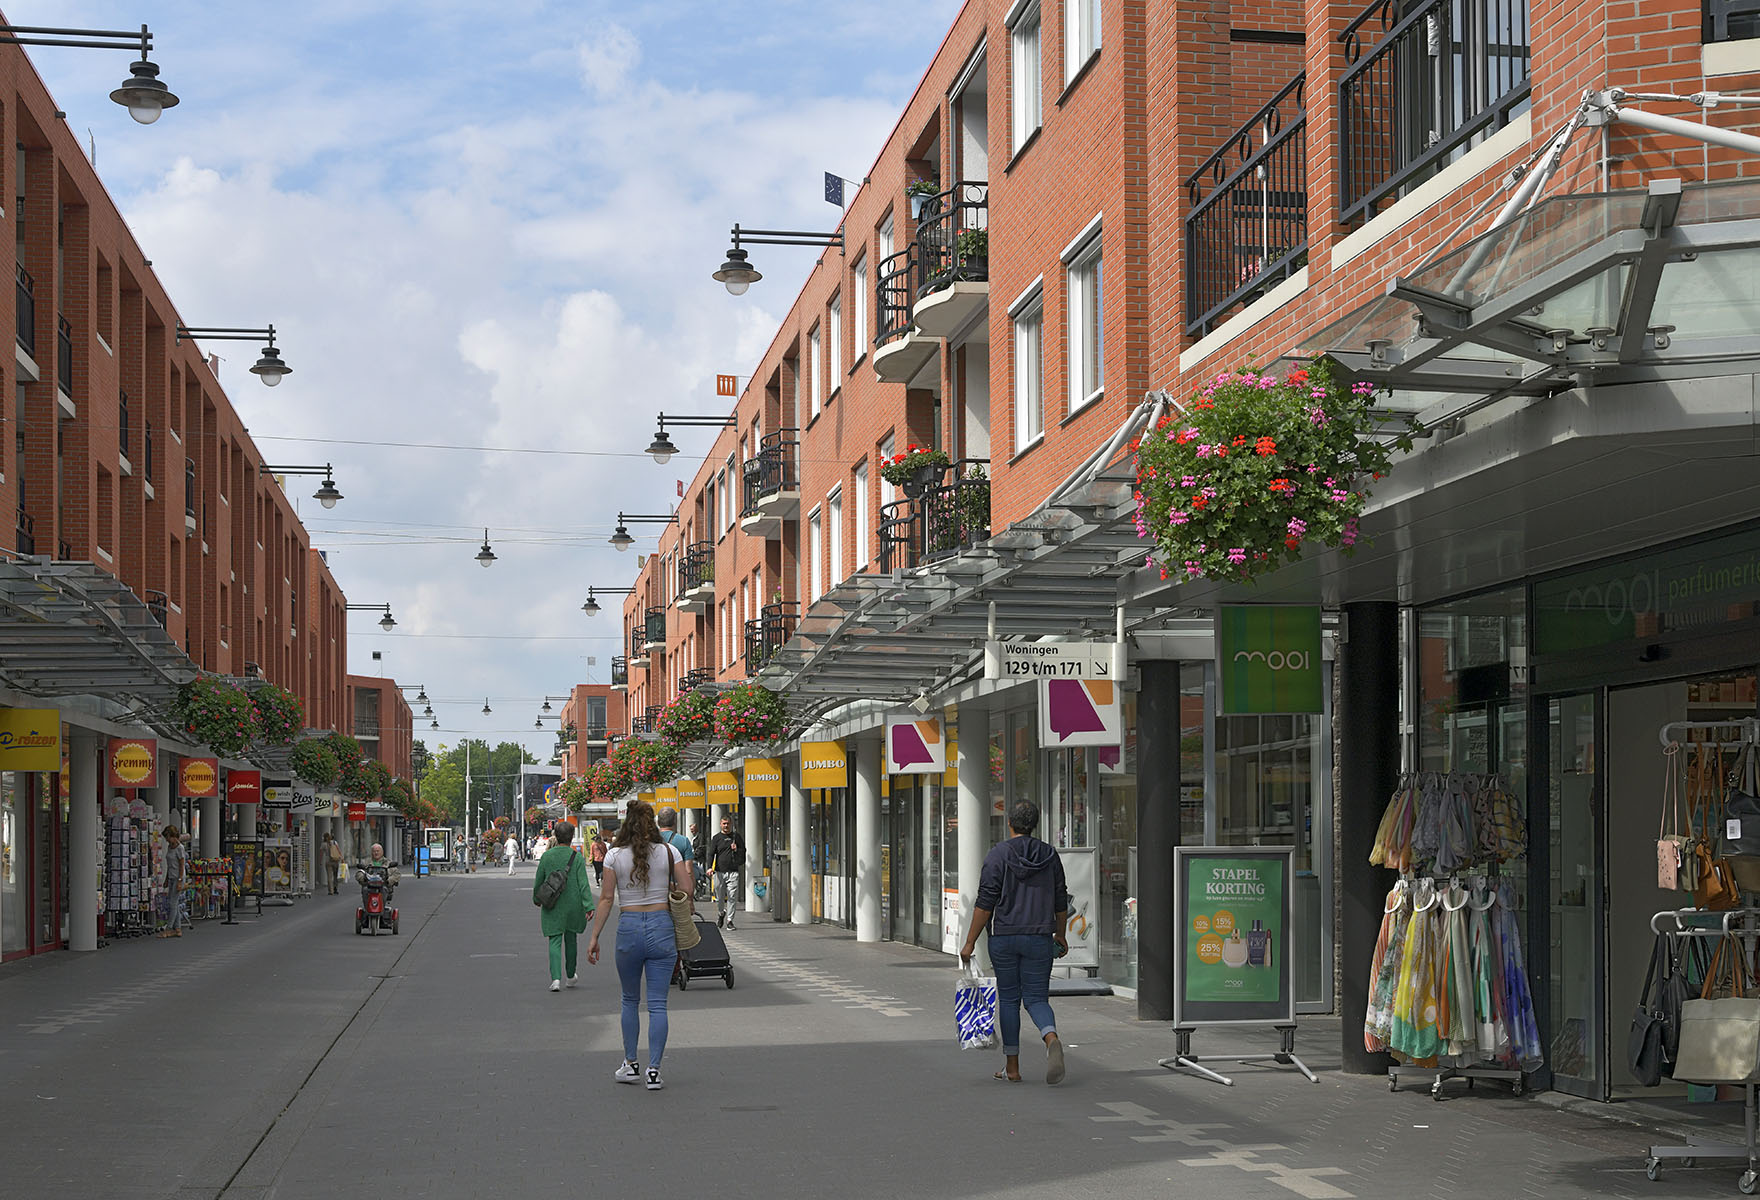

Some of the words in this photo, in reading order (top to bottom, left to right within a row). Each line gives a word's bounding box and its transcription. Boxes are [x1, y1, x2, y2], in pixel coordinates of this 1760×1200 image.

[1005, 645, 1058, 656] Woningen
[1234, 650, 1309, 670] mooi
[1005, 661, 1030, 675] 129
[1032, 661, 1057, 676] t/m
[1060, 661, 1082, 675] 171
[112, 756, 155, 771] Gremmy
[802, 760, 845, 770] JUMBO
[181, 771, 216, 784] Gremmy
[746, 774, 779, 782] JUMBO
[708, 784, 737, 792] JUMBO
[292, 792, 313, 804] Etos
[1212, 868, 1260, 880] STAPEL
[1206, 882, 1265, 895] KORTING
[1216, 918, 1231, 926] 15%
[1201, 943, 1221, 953] 25%
